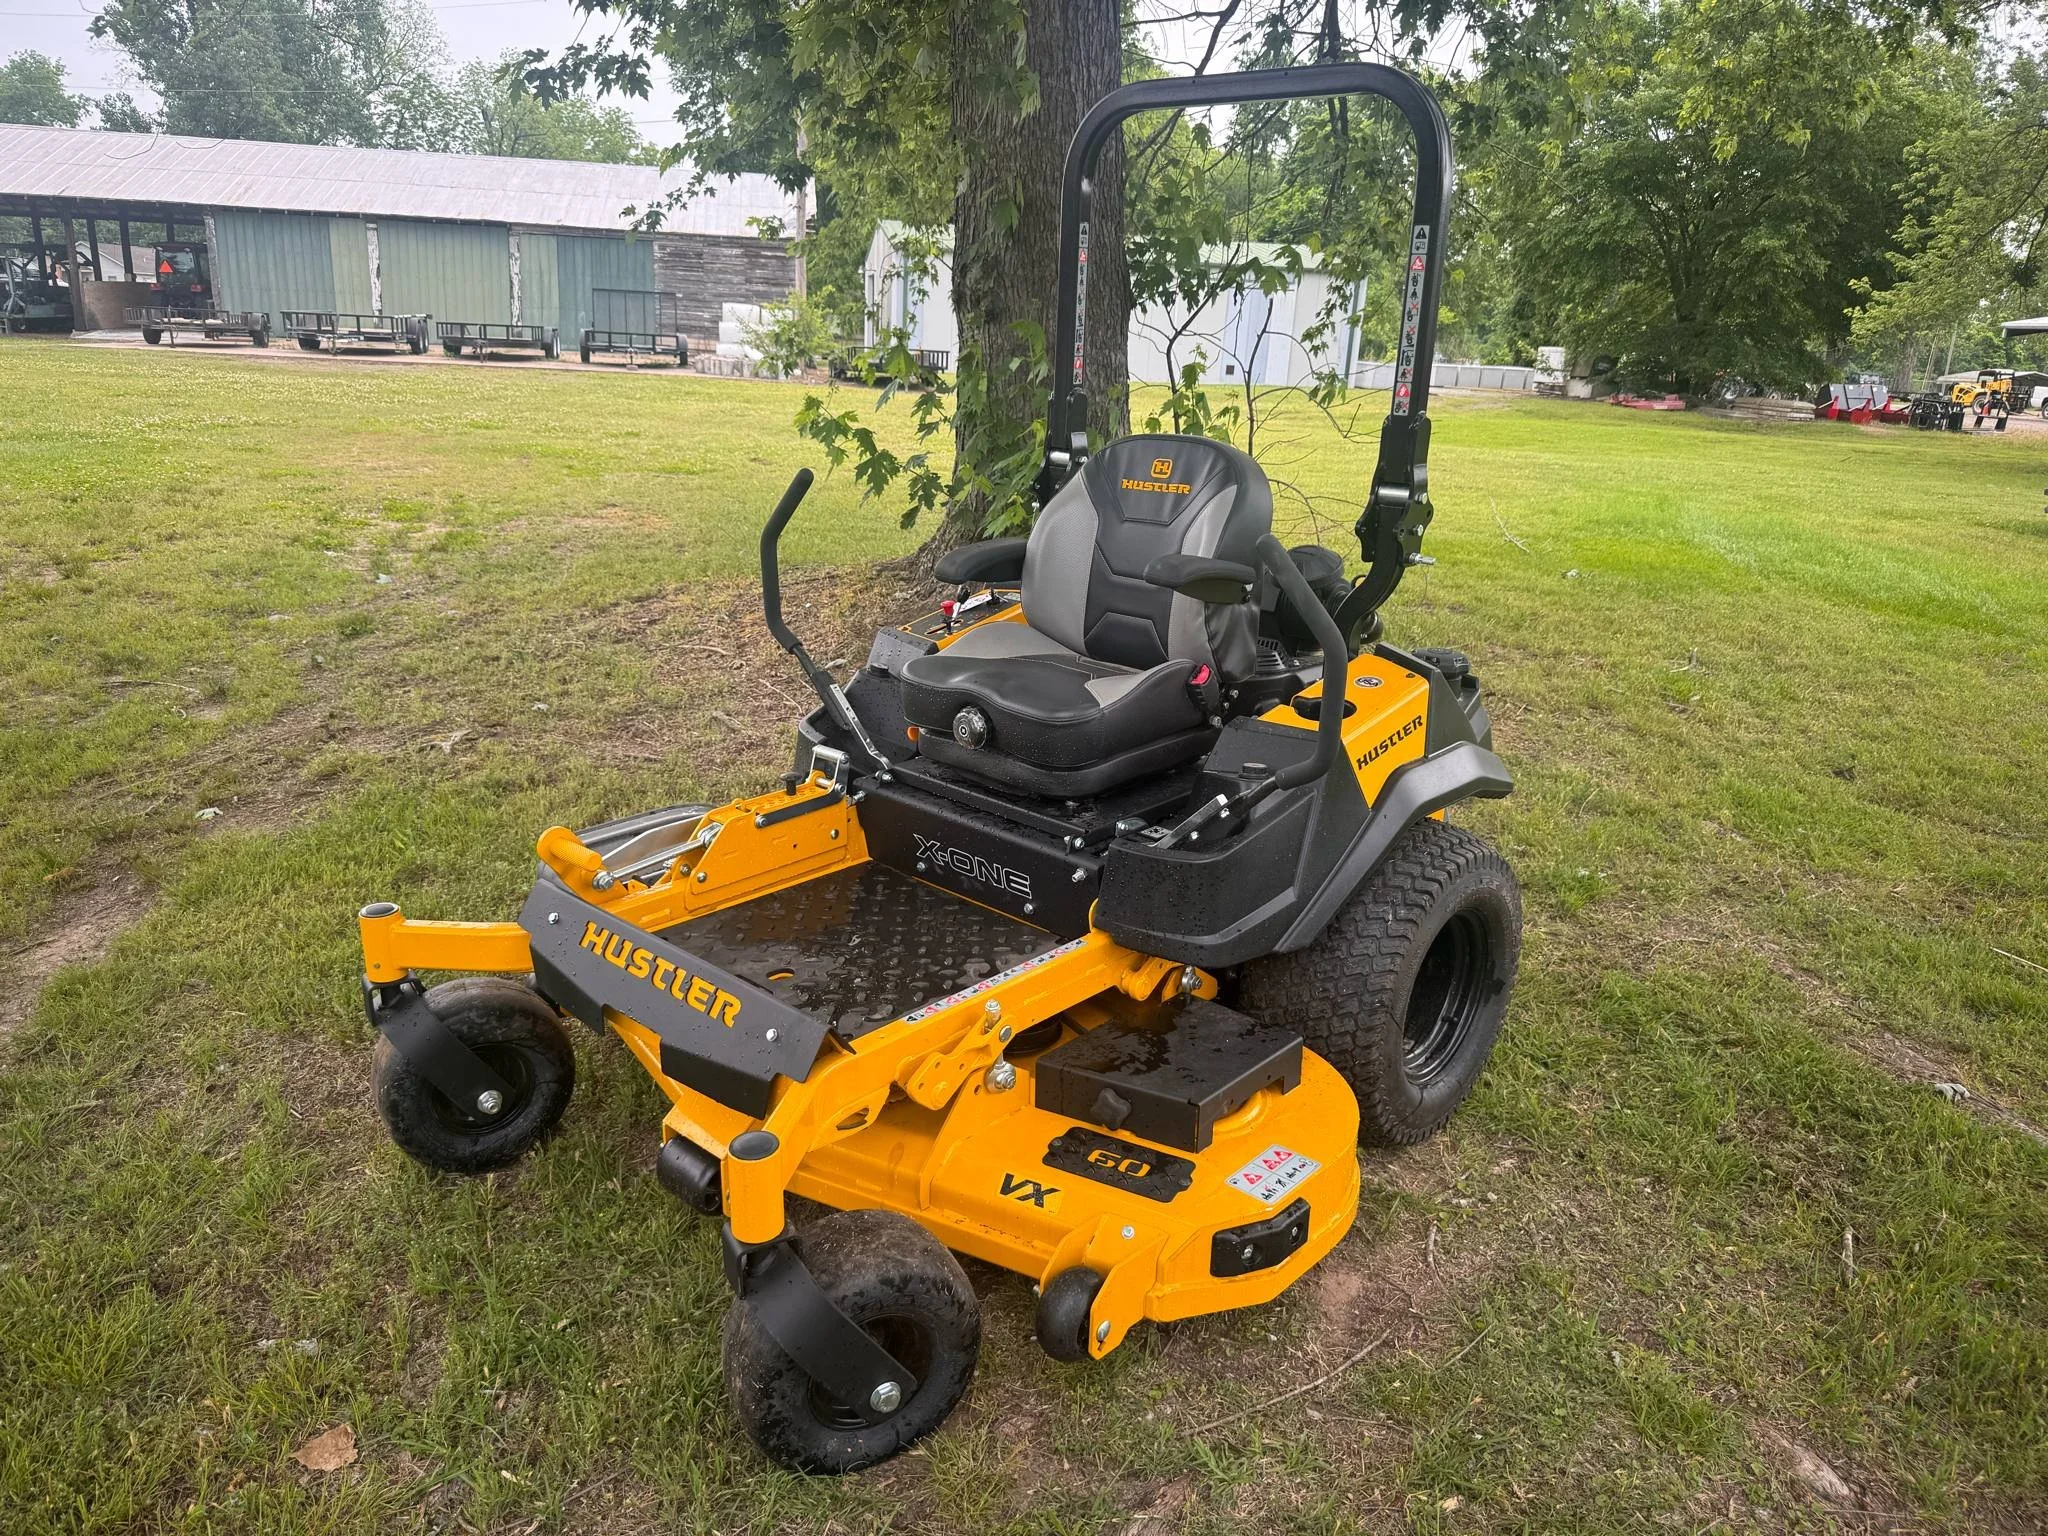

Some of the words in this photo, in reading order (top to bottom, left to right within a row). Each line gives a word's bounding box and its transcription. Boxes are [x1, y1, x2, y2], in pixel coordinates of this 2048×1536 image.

[1121, 479, 1190, 494] HUSTLER
[1356, 715, 1423, 770] HUSTLER
[913, 833, 1032, 899] X-ONE
[579, 920, 742, 1028] HUSTLER
[1087, 1149, 1151, 1178] 60
[1000, 1172, 1061, 1208] VX
